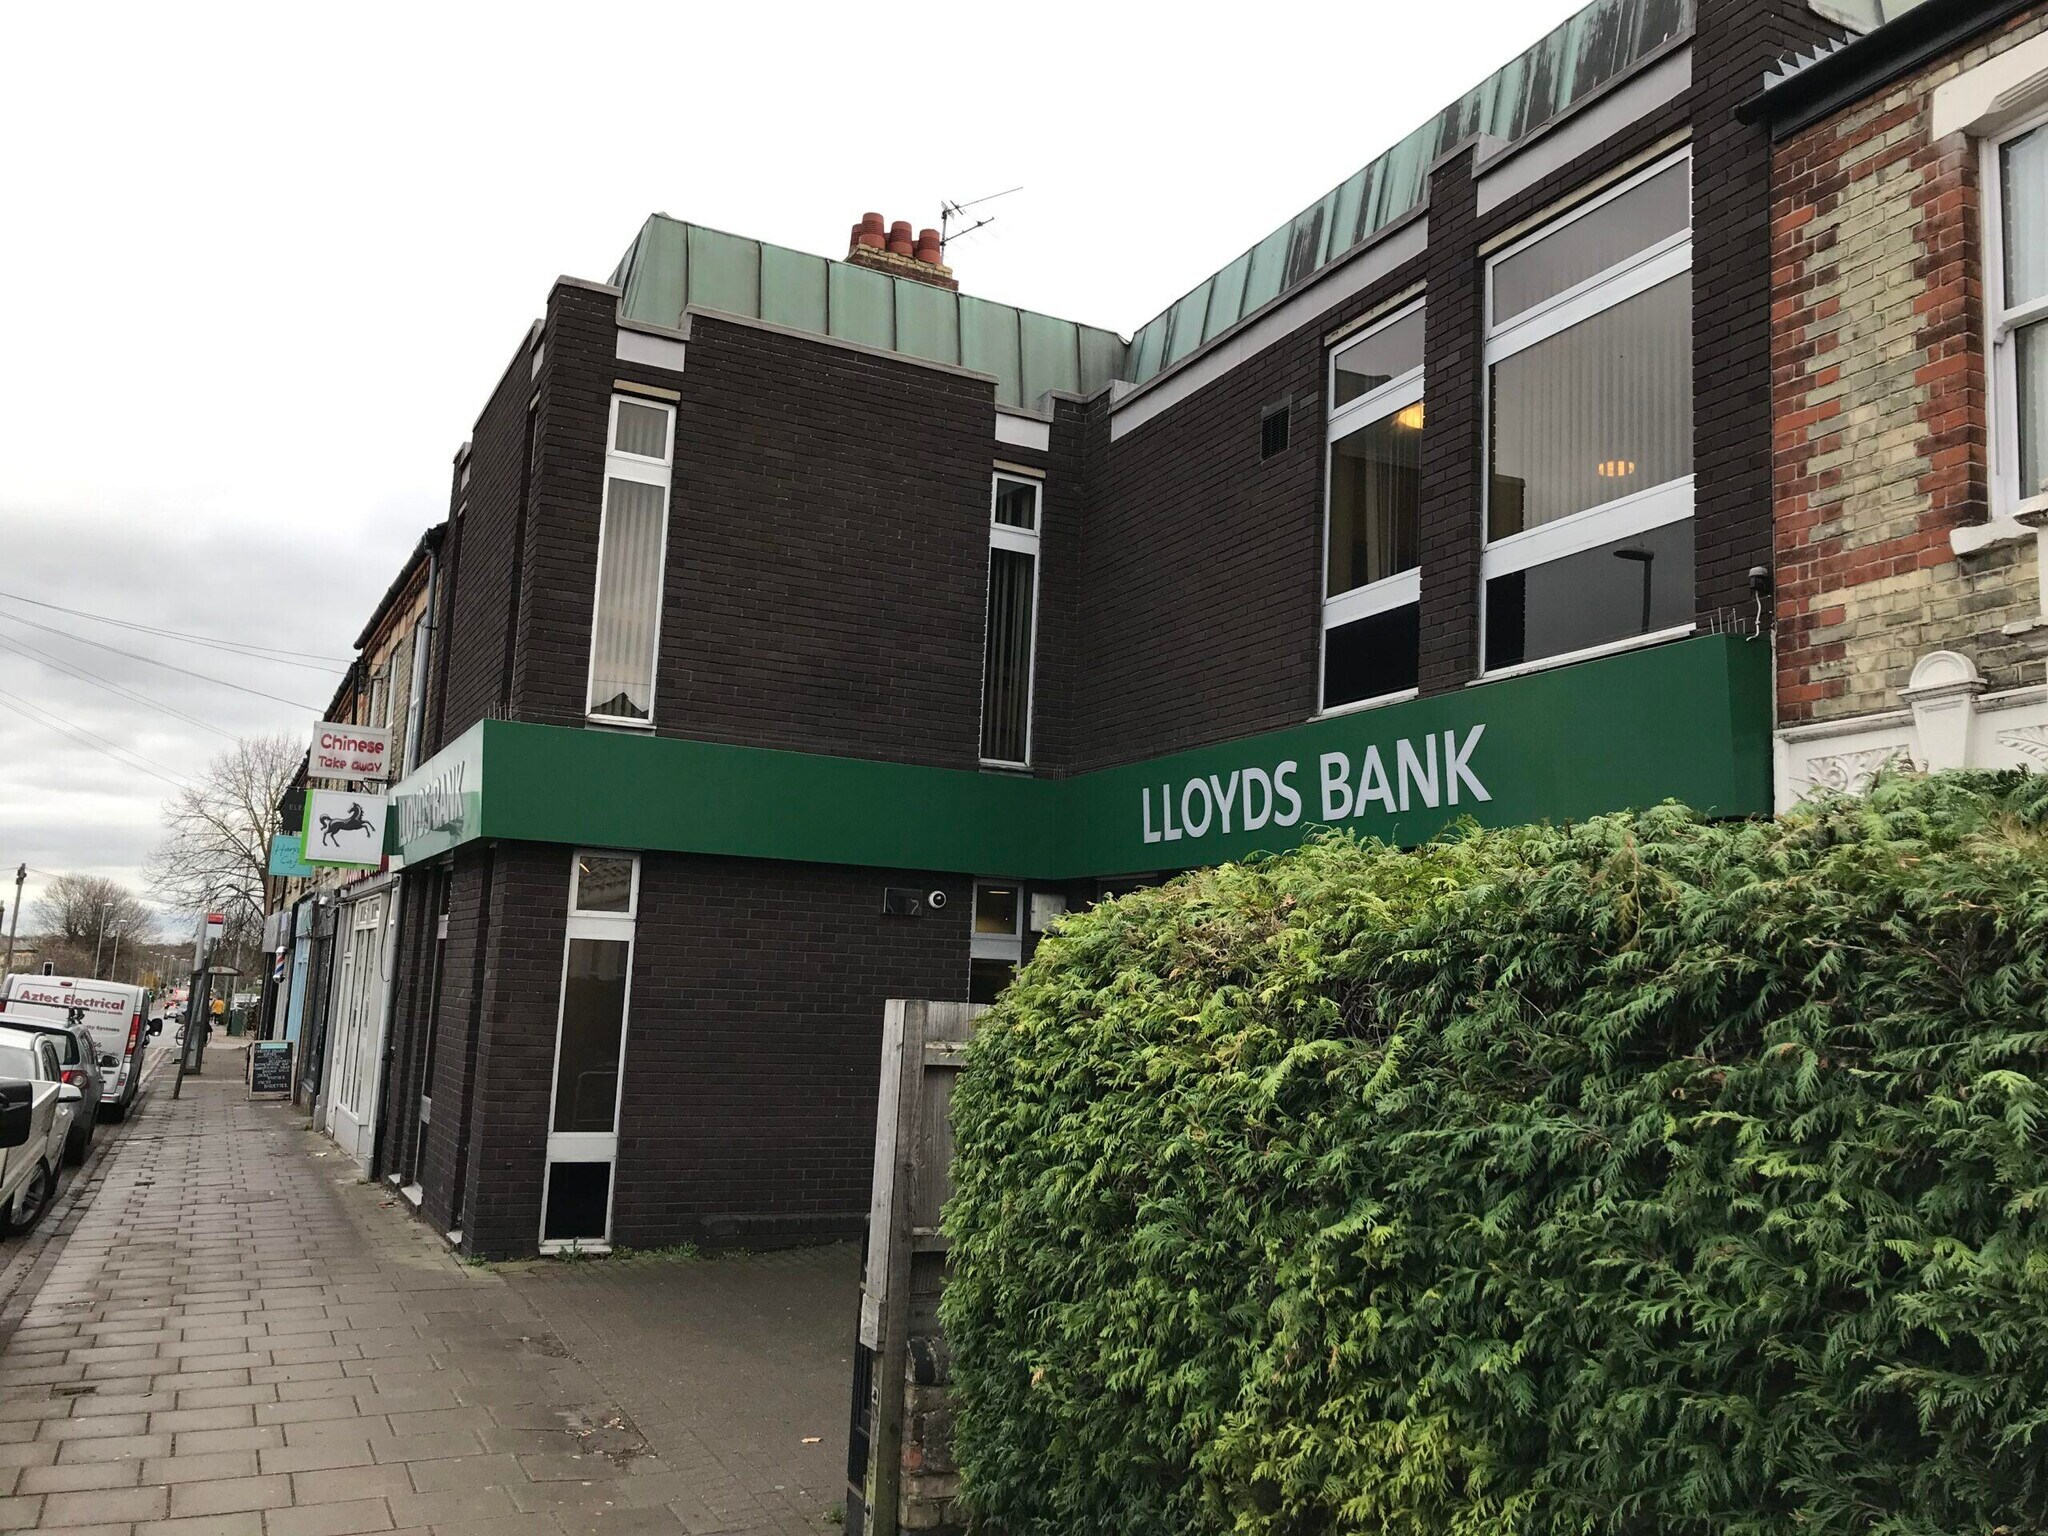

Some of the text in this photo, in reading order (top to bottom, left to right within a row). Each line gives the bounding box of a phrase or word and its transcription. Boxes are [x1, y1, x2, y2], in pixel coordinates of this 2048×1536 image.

[320, 733, 385, 754] Chinese
[318, 755, 383, 772] Take away
[1142, 723, 1494, 845] LLOYDS BANK
[398, 760, 466, 848] LLOYDS BANK
[20, 990, 126, 1011] Aztec Electrical
